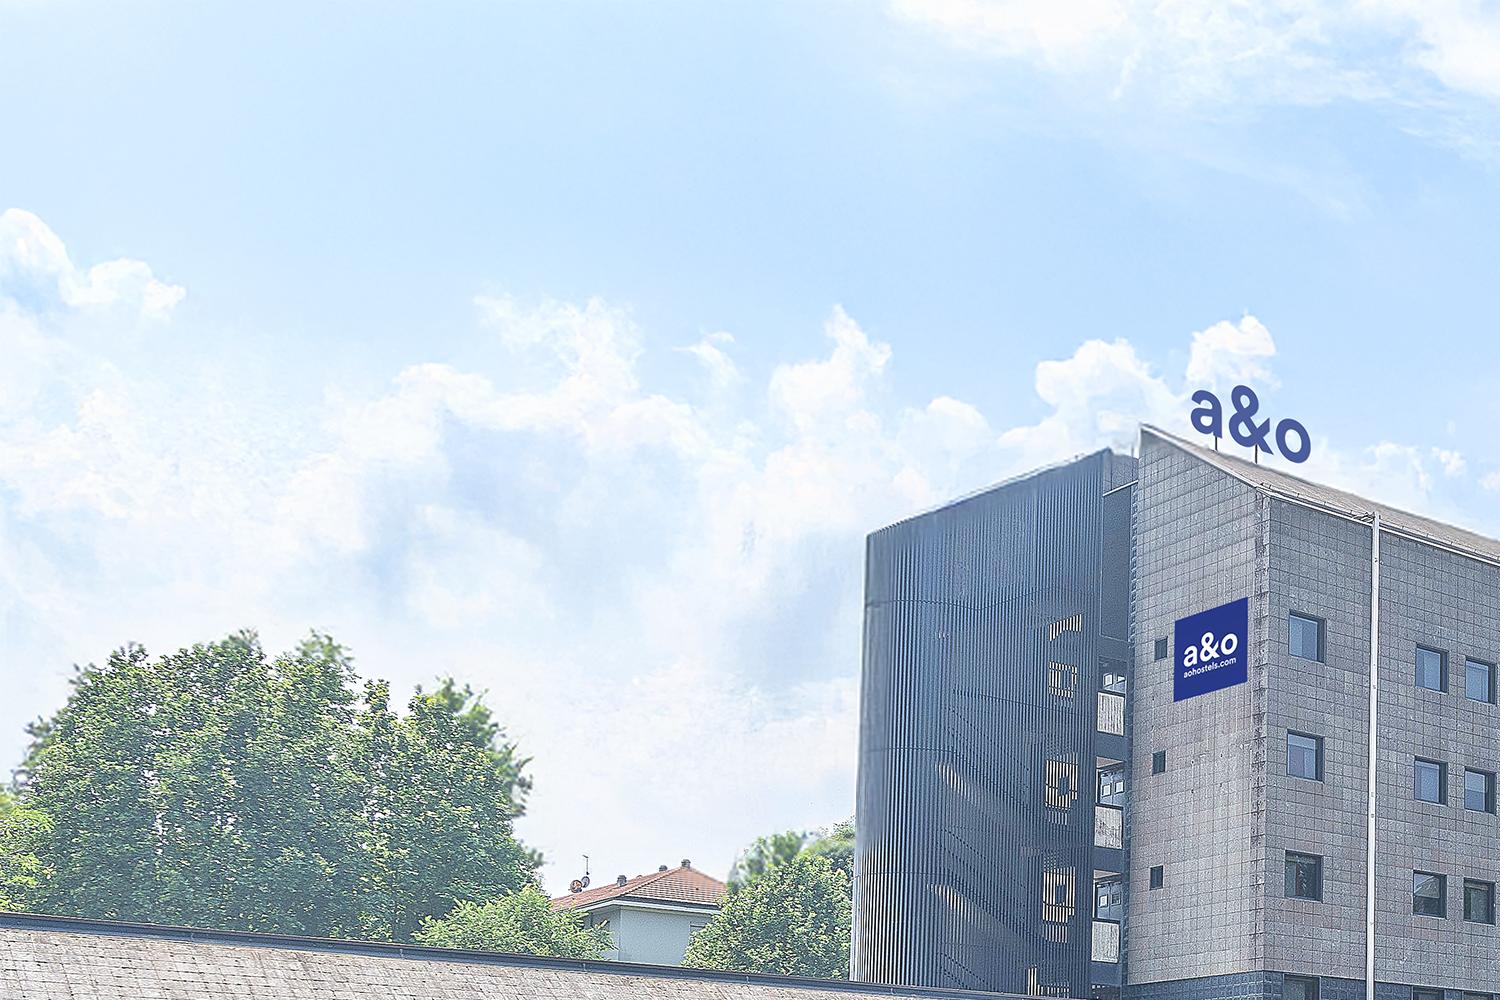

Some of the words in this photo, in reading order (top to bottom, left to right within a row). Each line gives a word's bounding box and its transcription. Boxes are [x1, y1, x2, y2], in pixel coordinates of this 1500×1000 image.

[1190, 384, 1311, 464] a&o
[1183, 631, 1238, 667] a&o
[1183, 657, 1237, 679] aohostels.com
